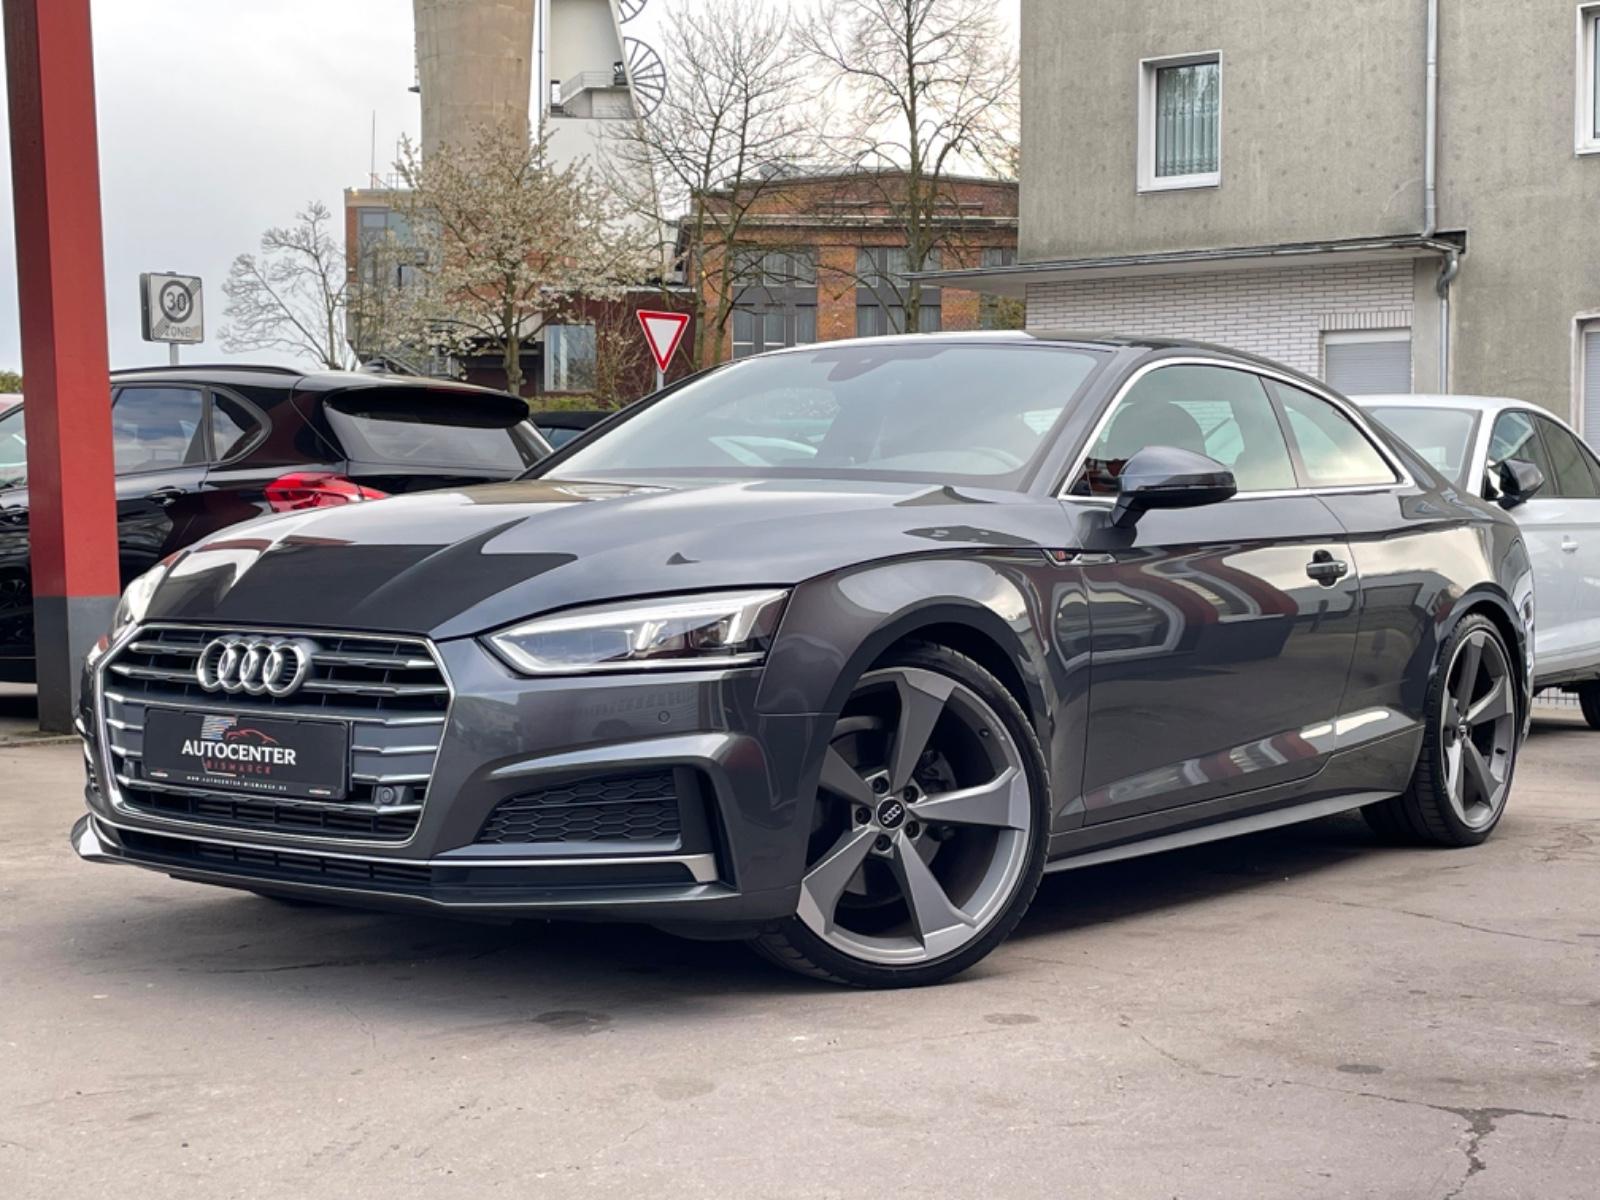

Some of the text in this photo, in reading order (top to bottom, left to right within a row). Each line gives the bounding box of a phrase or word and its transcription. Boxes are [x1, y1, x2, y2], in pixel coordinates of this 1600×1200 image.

[166, 291, 187, 312] 30
[165, 324, 192, 337] ZONE
[181, 739, 297, 765] AUTOCENTER
[206, 760, 272, 775] BISMARCK
